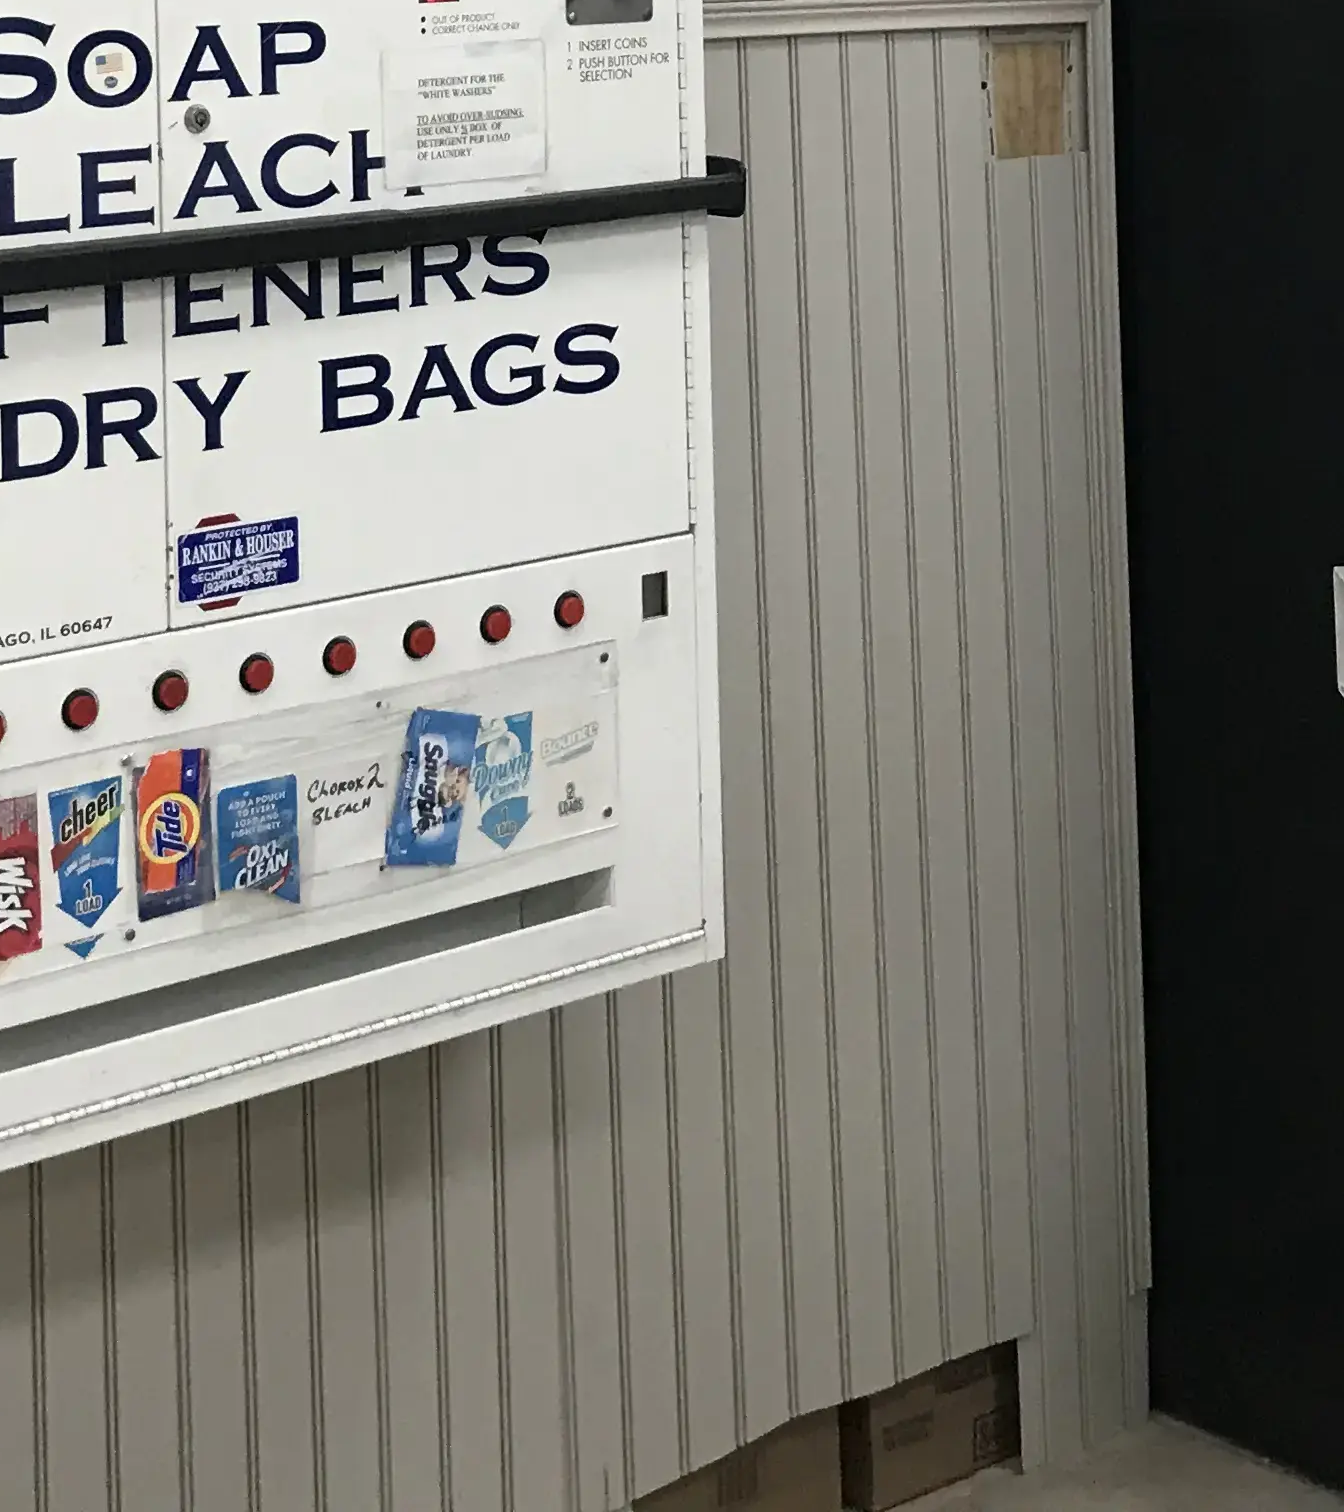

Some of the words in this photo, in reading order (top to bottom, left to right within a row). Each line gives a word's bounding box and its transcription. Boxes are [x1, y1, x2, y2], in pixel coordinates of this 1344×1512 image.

[431, 15, 447, 25] OUT
[449, 14, 459, 24] OF
[461, 12, 495, 23] PRODUCT
[431, 24, 466, 35] CORRECT
[467, 22, 499, 33] CHANGE
[501, 21, 520, 31] ONLY
[567, 41, 571, 52] 1
[579, 38, 611, 52] INSERT
[614, 36, 648, 50] COINS
[566, 58, 573, 71] 2
[579, 56, 605, 70] PUSH
[607, 53, 648, 68] BUTTON
[650, 52, 670, 64] FOR
[417, 75, 468, 88] DETERGENT
[470, 74, 487, 85] FOR
[488, 73, 504, 83] THE
[580, 67, 632, 83] SELECTION
[417, 89, 451, 100] "WHITE
[416, 127, 434, 136] USE
[435, 124, 459, 135] ONLY
[469, 123, 488, 133] BOX
[491, 121, 502, 131] OF
[417, 115, 429, 127] TO
[430, 112, 459, 126] AVOID
[417, 136, 468, 149] DETERGENT
[469, 134, 485, 144] PER
[487, 132, 511, 143] LOAD
[417, 151, 428, 161] OF
[319, 323, 620, 433] BAGS
[206, 525, 258, 541] PROTECTED
[260, 523, 272, 533] BY
[182, 539, 232, 567] RANKIN
[234, 538, 244, 558] &
[246, 529, 295, 556] HOUSER
[191, 565, 241, 584] SECURITY
[40, 626, 56, 641] IL
[60, 615, 113, 637] 60647
[540, 720, 599, 761] Bounce
[367, 762, 385, 791] 2
[473, 750, 534, 793] Downy
[228, 798, 247, 811] ADD
[248, 798, 254, 807] A
[255, 790, 286, 804] POUCH
[62, 786, 116, 843] cheer
[238, 808, 249, 818] TO
[312, 795, 372, 826] BLEACH
[155, 800, 188, 858] Tide
[235, 849, 289, 890] CLEAN
[84, 879, 93, 898] 1
[76, 896, 103, 914] LOAD
